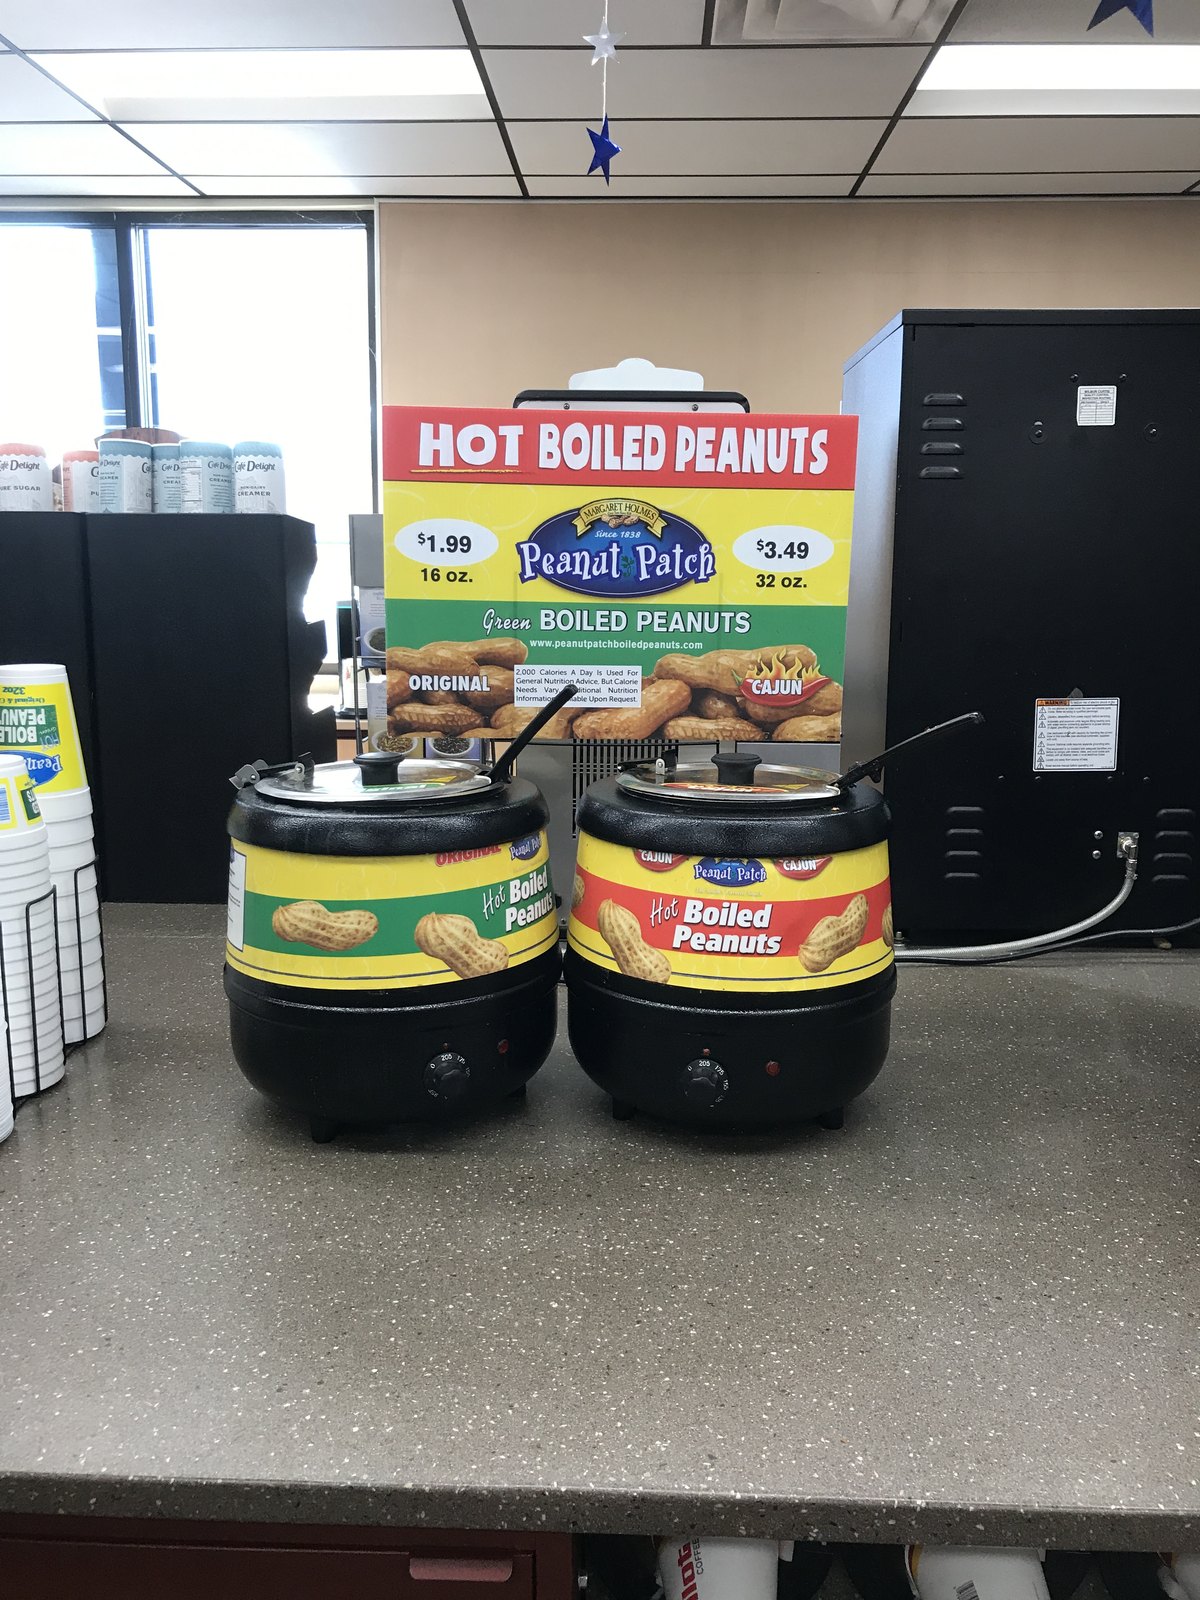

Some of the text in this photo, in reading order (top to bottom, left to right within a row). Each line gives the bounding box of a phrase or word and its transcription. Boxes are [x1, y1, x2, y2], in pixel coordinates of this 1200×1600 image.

[418, 422, 829, 475] HOT BOILED PEANUTS
[10, 460, 40, 472] Delight
[235, 460, 276, 472] Café Delight
[583, 502, 657, 521] MARGARET HOLMES
[417, 531, 472, 553] $1.99
[594, 529, 642, 539] Since 1838
[756, 538, 810, 560] $3.49
[519, 541, 715, 582] Peanut Patch
[421, 568, 473, 582] 16 oz.
[755, 574, 807, 588] 32 oz.
[482, 608, 751, 634] Green BOILED PEANUTS
[529, 639, 703, 650] www.peanutpatchboiledpeanuts.com
[539, 668, 568, 676] Calories
[579, 669, 594, 678] Day
[543, 677, 574, 685] Nutrition
[613, 678, 639, 686] Calorie
[2, 686, 26, 695] 32oz
[408, 674, 491, 692] ORIGINAL
[751, 679, 803, 695] CAJUN
[588, 696, 608, 704] Upon
[608, 696, 638, 704] Request.
[0, 708, 46, 726] PEANU
[0, 726, 37, 743] BOILE
[27, 755, 63, 772] Pean
[641, 849, 673, 864] CAJUN
[782, 859, 817, 871] CAJUN
[694, 864, 767, 882] Peanut Patch
[483, 865, 548, 921] Hot Boiled
[505, 891, 553, 932] Peanuts
[650, 896, 773, 928] Hot Boiled
[672, 925, 782, 955] Peanuts
[692, 1538, 704, 1575] COFFEE
